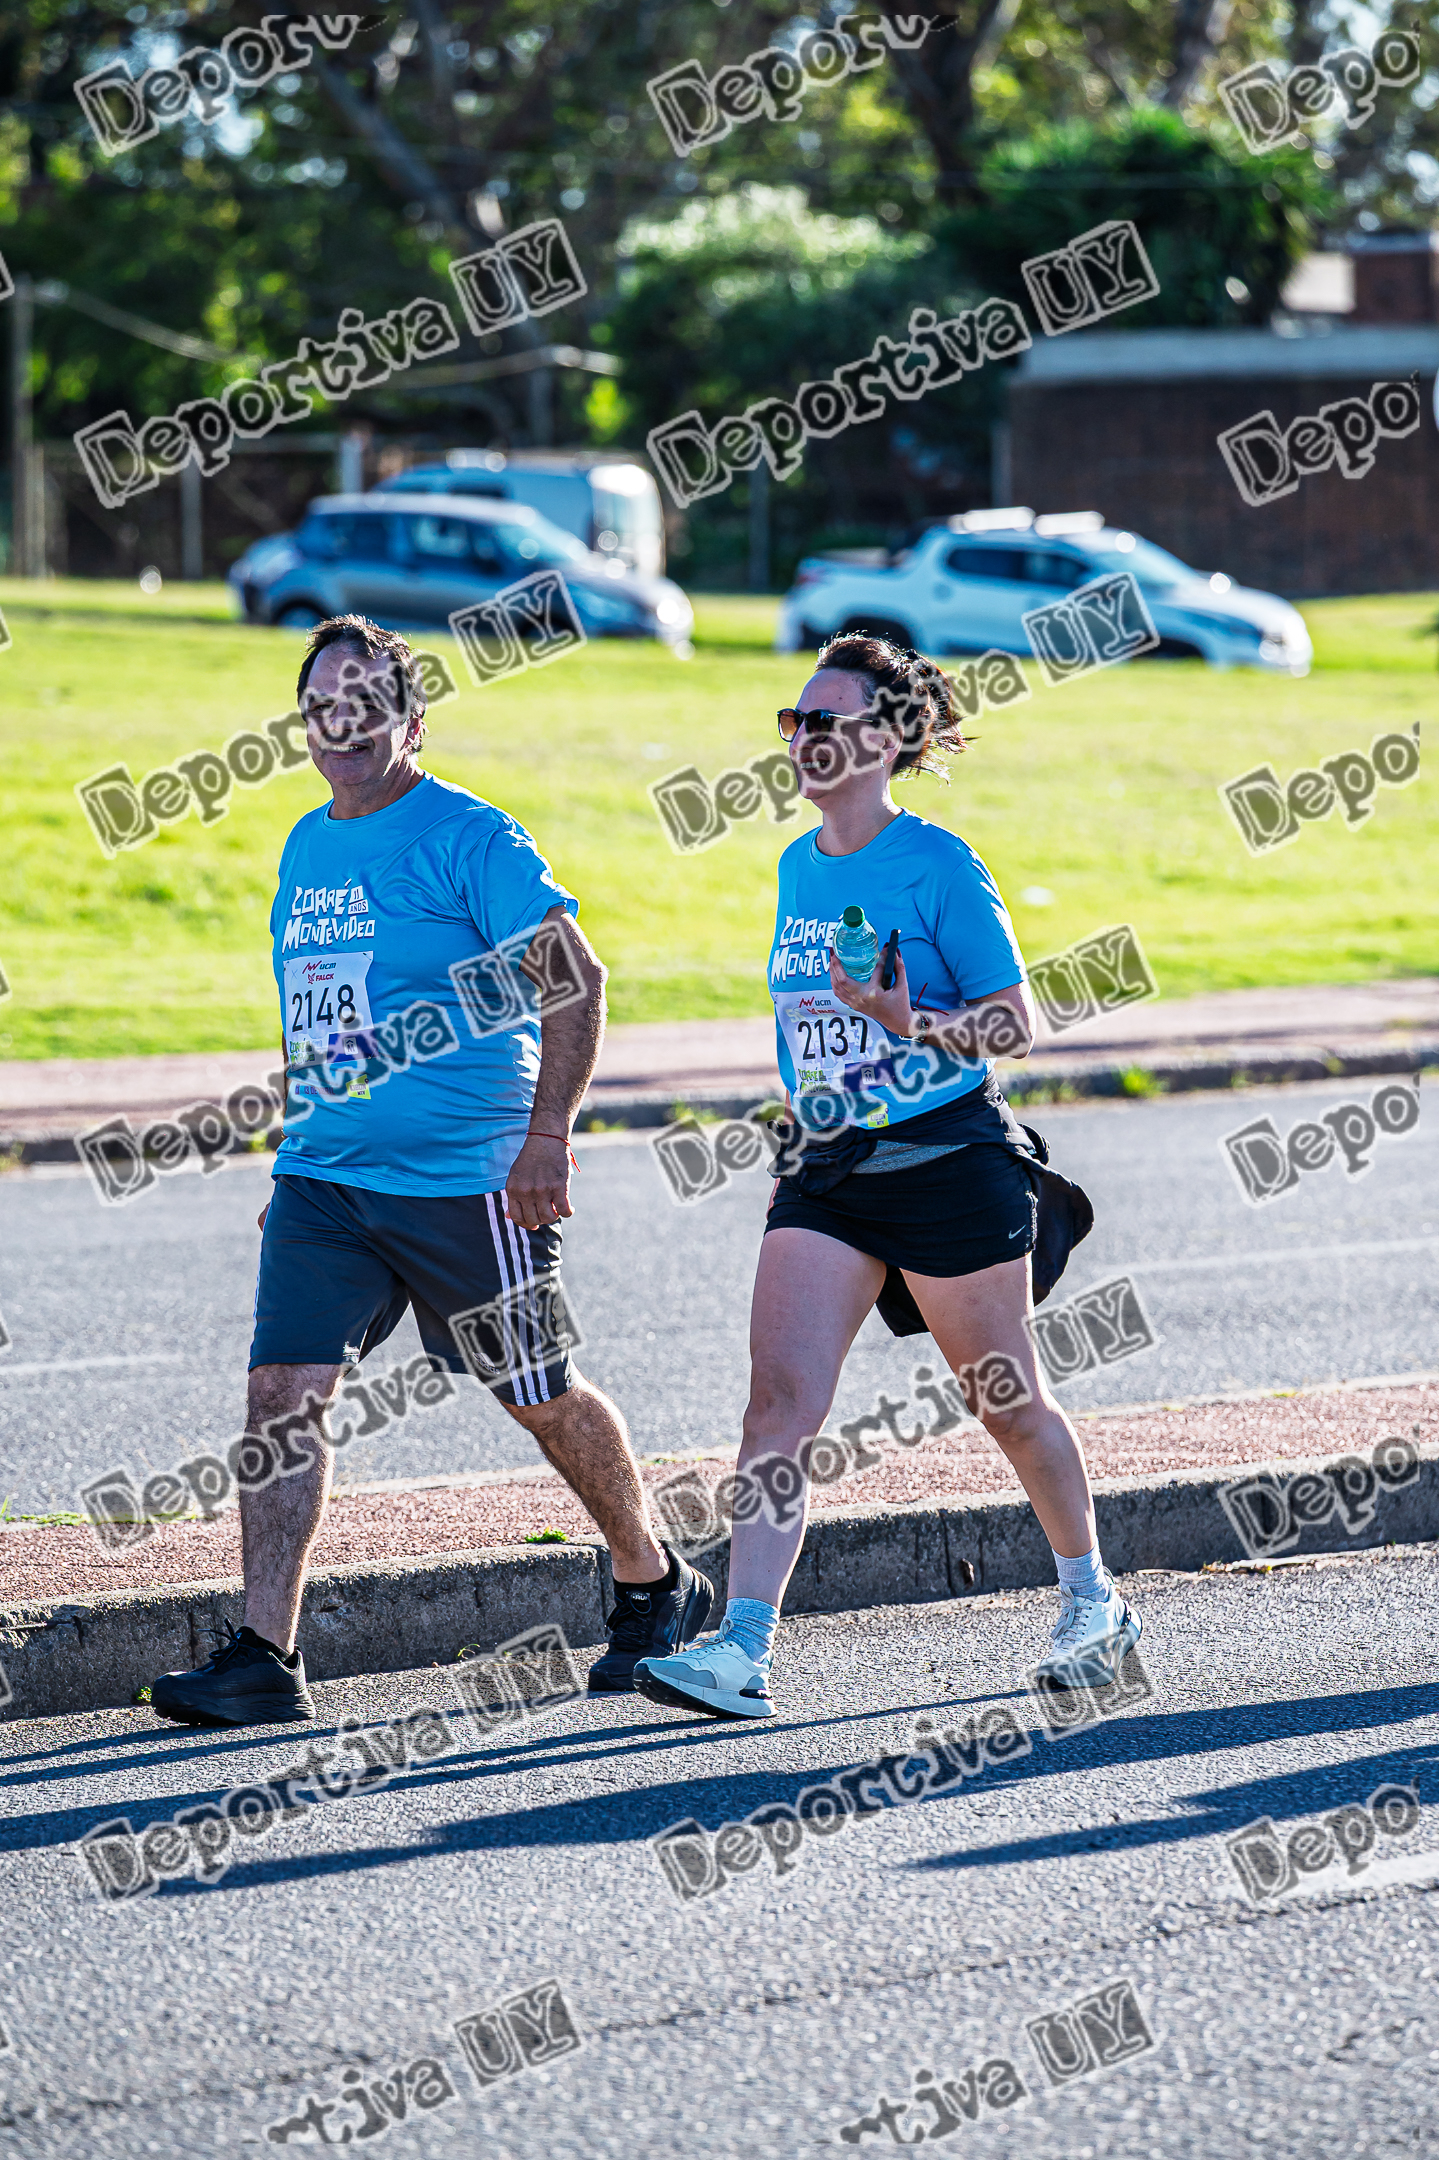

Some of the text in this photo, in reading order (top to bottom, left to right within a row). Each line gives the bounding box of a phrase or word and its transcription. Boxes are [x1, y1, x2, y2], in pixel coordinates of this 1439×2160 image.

[349, 900, 367, 913] AÑOS
[282, 915, 375, 955] MONTEVIDEO
[315, 973, 335, 982] FALCK
[771, 946, 831, 987] MONTEV
[292, 983, 357, 1033] 2148
[814, 999, 832, 1007] ucm
[797, 1015, 868, 1061] 2137
